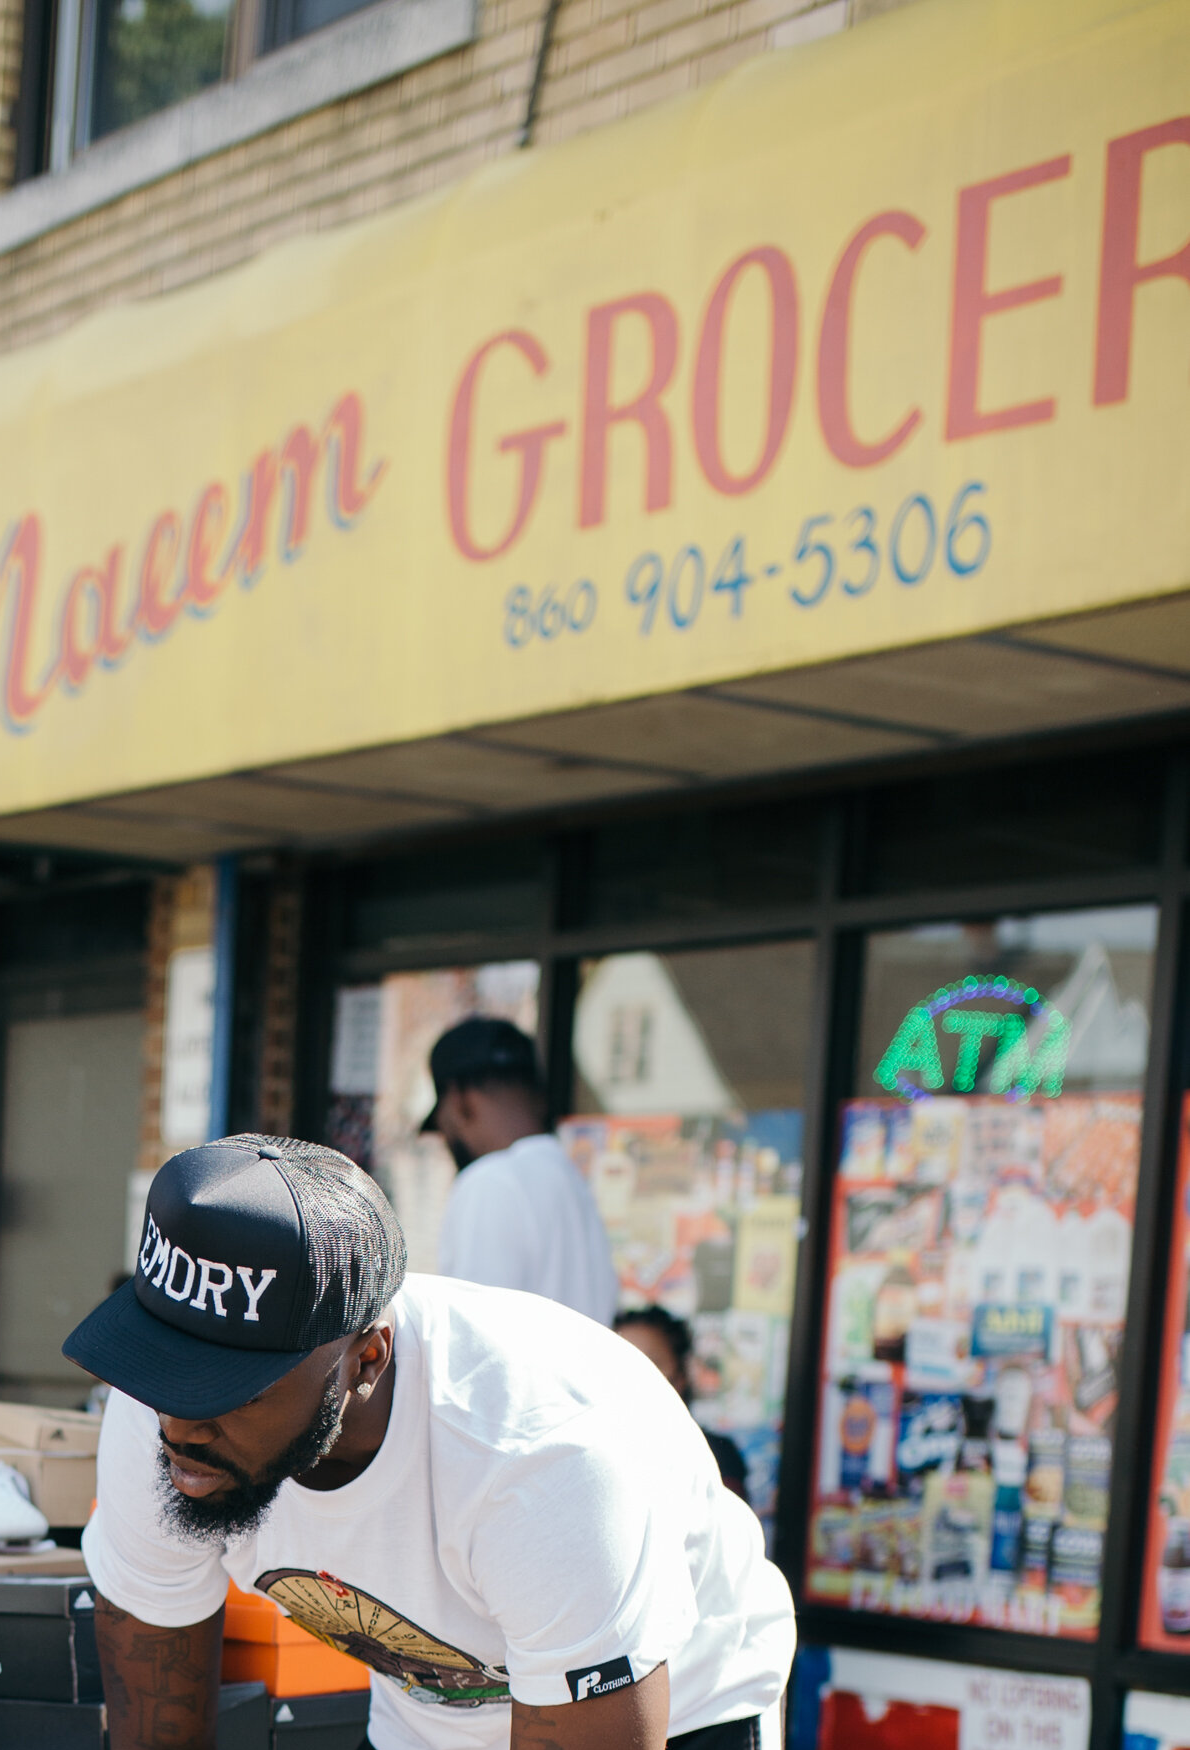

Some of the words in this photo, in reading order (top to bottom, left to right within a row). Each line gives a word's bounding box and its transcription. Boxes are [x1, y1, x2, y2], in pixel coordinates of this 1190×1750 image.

[504, 580, 598, 649] 860
[626, 481, 992, 636] 904-5306
[873, 1008, 1072, 1098] ATM
[140, 1212, 277, 1321] EMORY
[593, 1675, 631, 1694] CLOTHING
